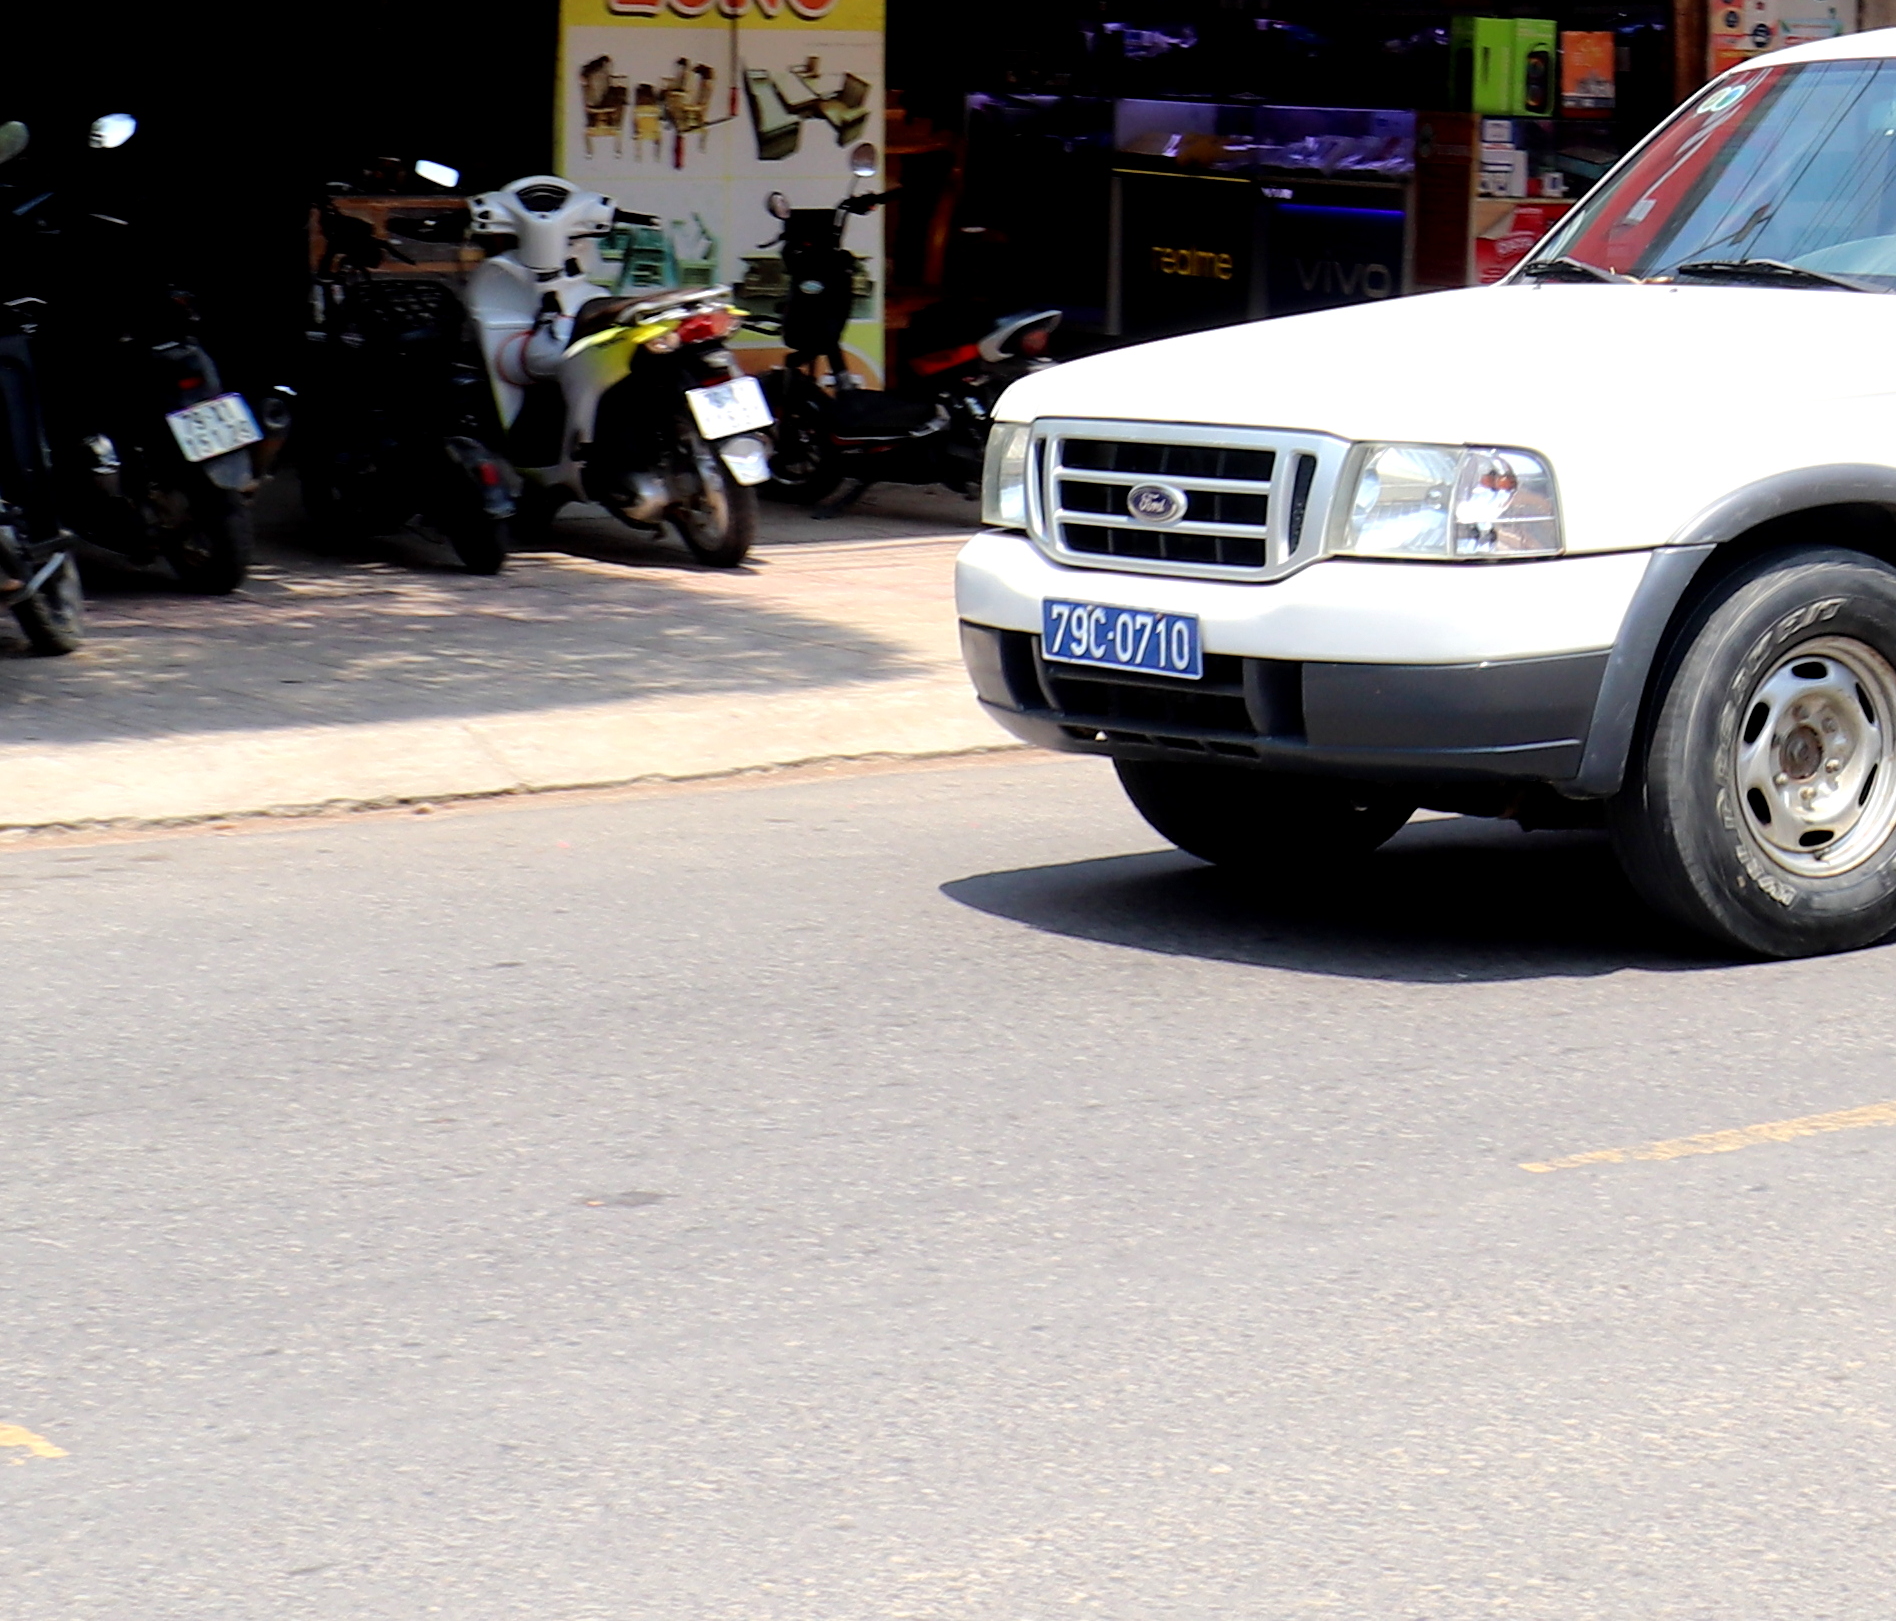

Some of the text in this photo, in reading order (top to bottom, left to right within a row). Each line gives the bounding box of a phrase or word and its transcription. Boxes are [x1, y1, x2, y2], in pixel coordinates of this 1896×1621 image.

[1152, 245, 1234, 281] realme
[1297, 252, 1393, 299] vivo
[1138, 492, 1167, 513] Ford
[1051, 603, 1191, 671] 79C-0710
